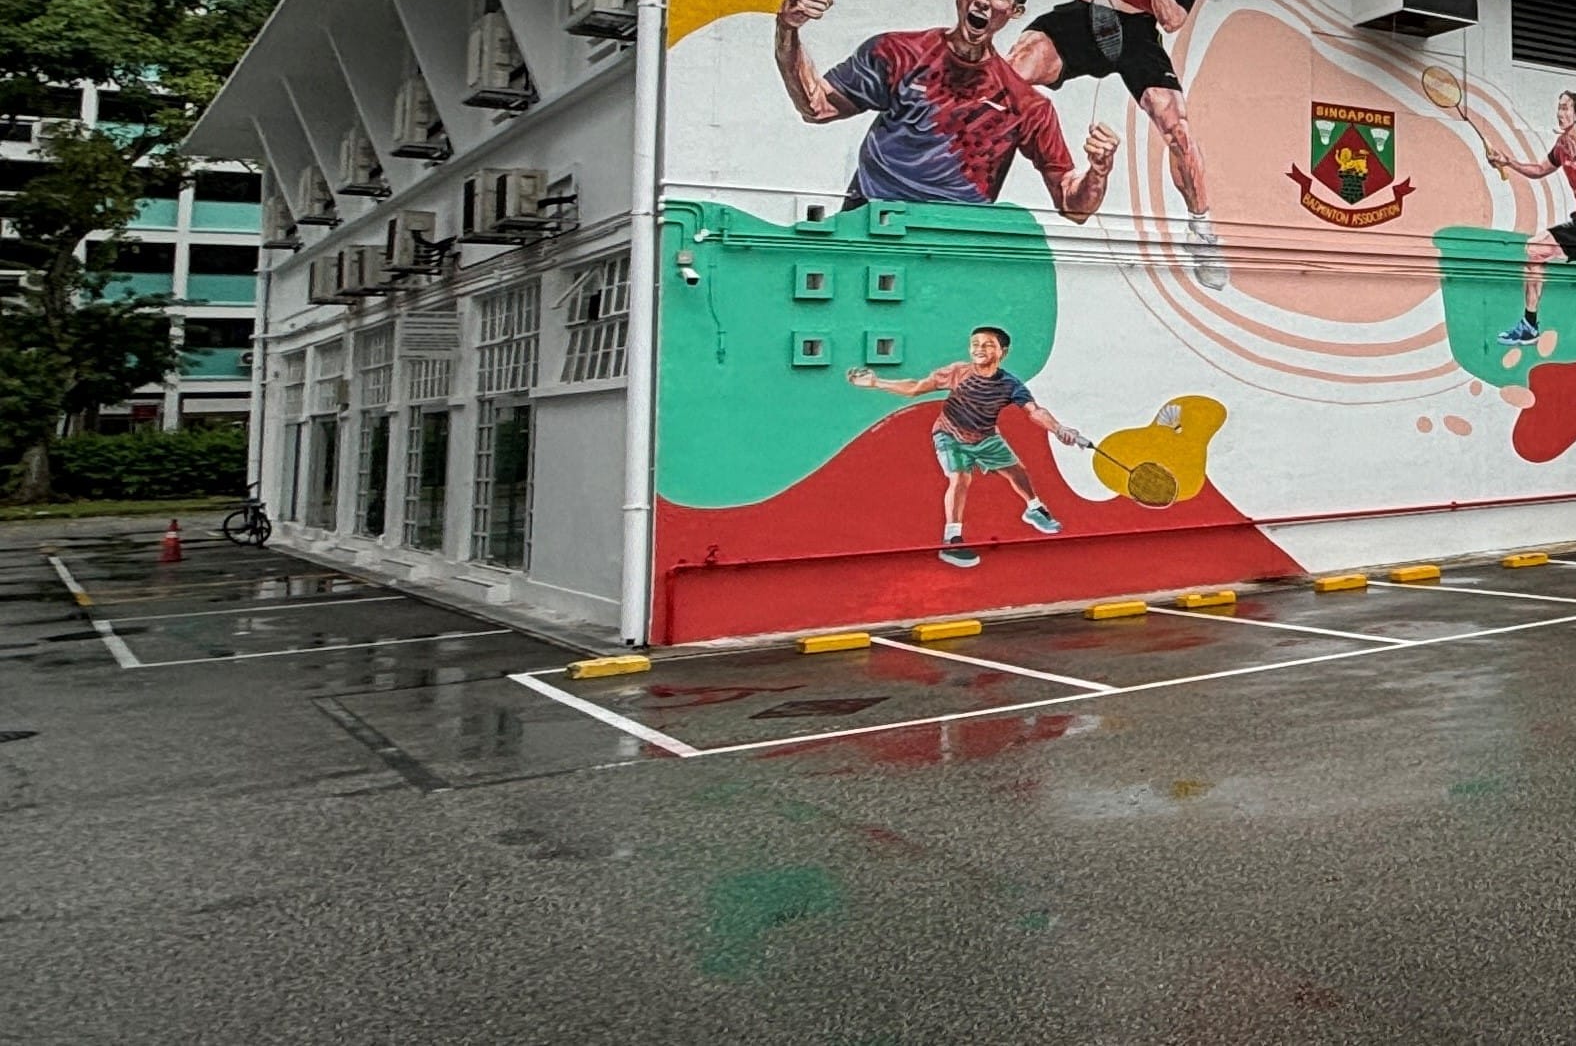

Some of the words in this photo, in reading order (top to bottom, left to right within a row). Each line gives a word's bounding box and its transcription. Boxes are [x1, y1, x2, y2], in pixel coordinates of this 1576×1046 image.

[1316, 106, 1391, 125] SINGAPORE
[1302, 194, 1349, 225] BADMINTON
[1351, 203, 1401, 225] ASSOCIATION
